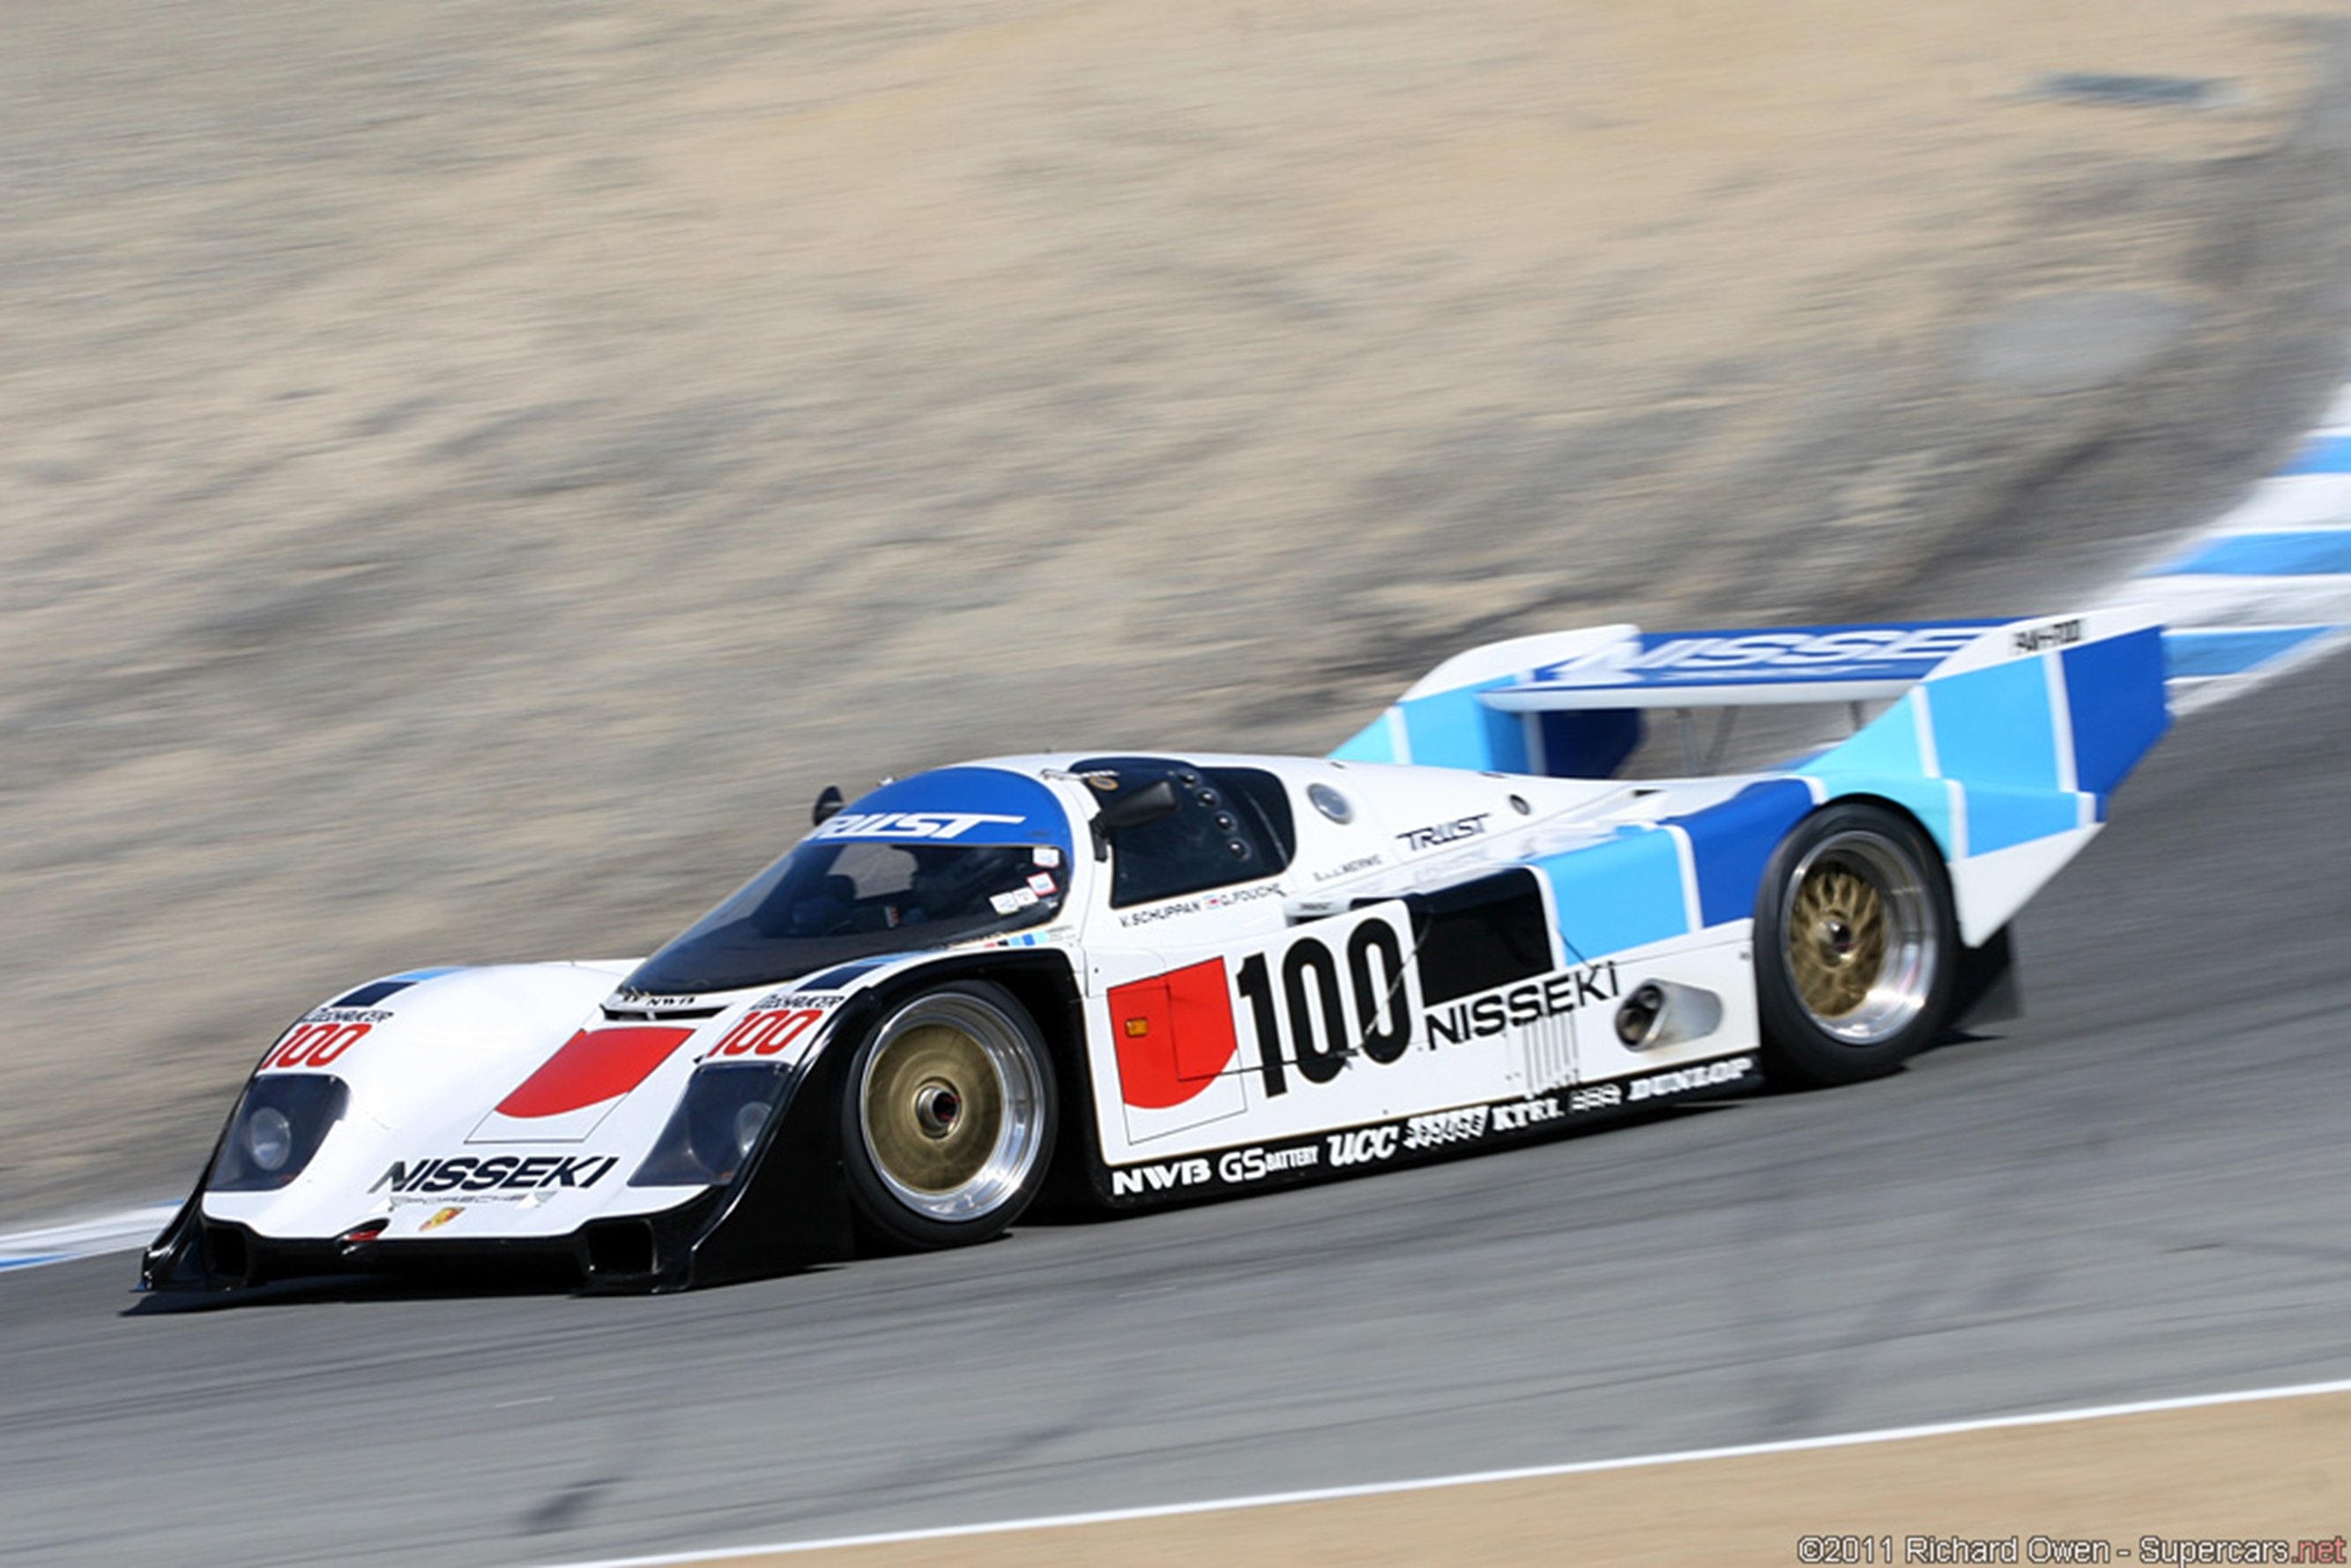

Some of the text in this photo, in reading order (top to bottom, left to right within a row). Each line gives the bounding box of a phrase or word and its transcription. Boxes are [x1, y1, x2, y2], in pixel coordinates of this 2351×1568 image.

[1395, 813, 1492, 851] TRUST
[1236, 918, 1411, 1098] 100
[1425, 961, 1619, 1051] NISSEKI
[260, 1023, 373, 1070] 100
[706, 1009, 824, 1058] 100
[1112, 1158, 1212, 1196] NWB
[1219, 1148, 1268, 1183] GS
[1264, 1145, 1320, 1173] BATTERY
[1327, 1125, 1400, 1167] UCC
[1626, 1057, 1754, 1101] DUNLOP
[367, 1156, 620, 1193] NISSEKI
